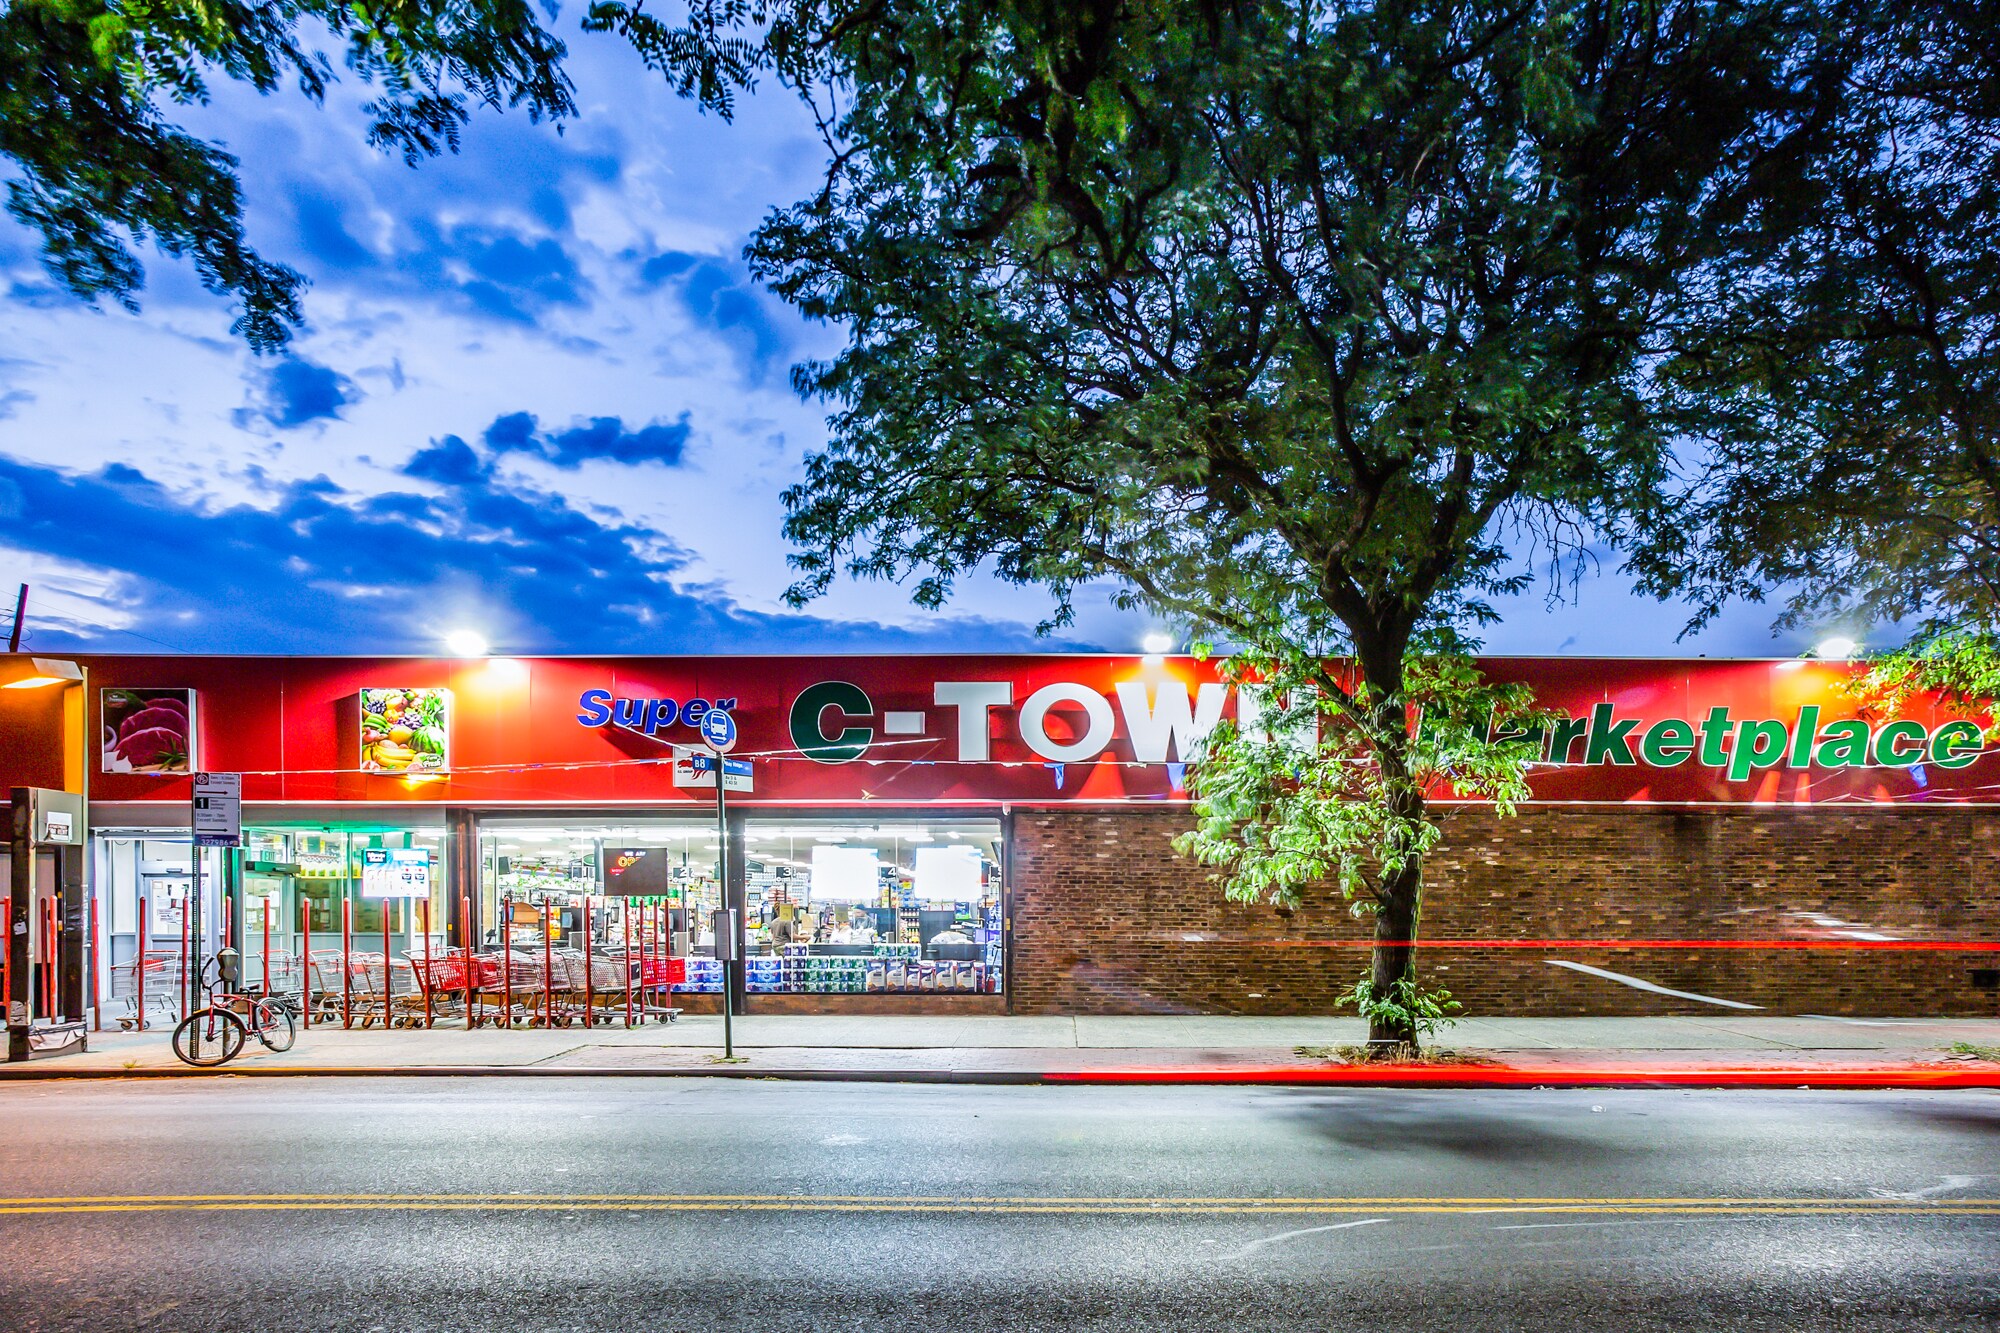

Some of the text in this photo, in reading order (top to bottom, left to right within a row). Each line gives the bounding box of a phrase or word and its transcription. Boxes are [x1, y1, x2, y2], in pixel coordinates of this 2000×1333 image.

[576, 688, 738, 736] Super
[788, 680, 1320, 765] C-TOWN
[694, 758, 706, 769] B8
[200, 798, 205, 809] 1
[783, 867, 791, 876] 3
[887, 867, 896, 877] 4
